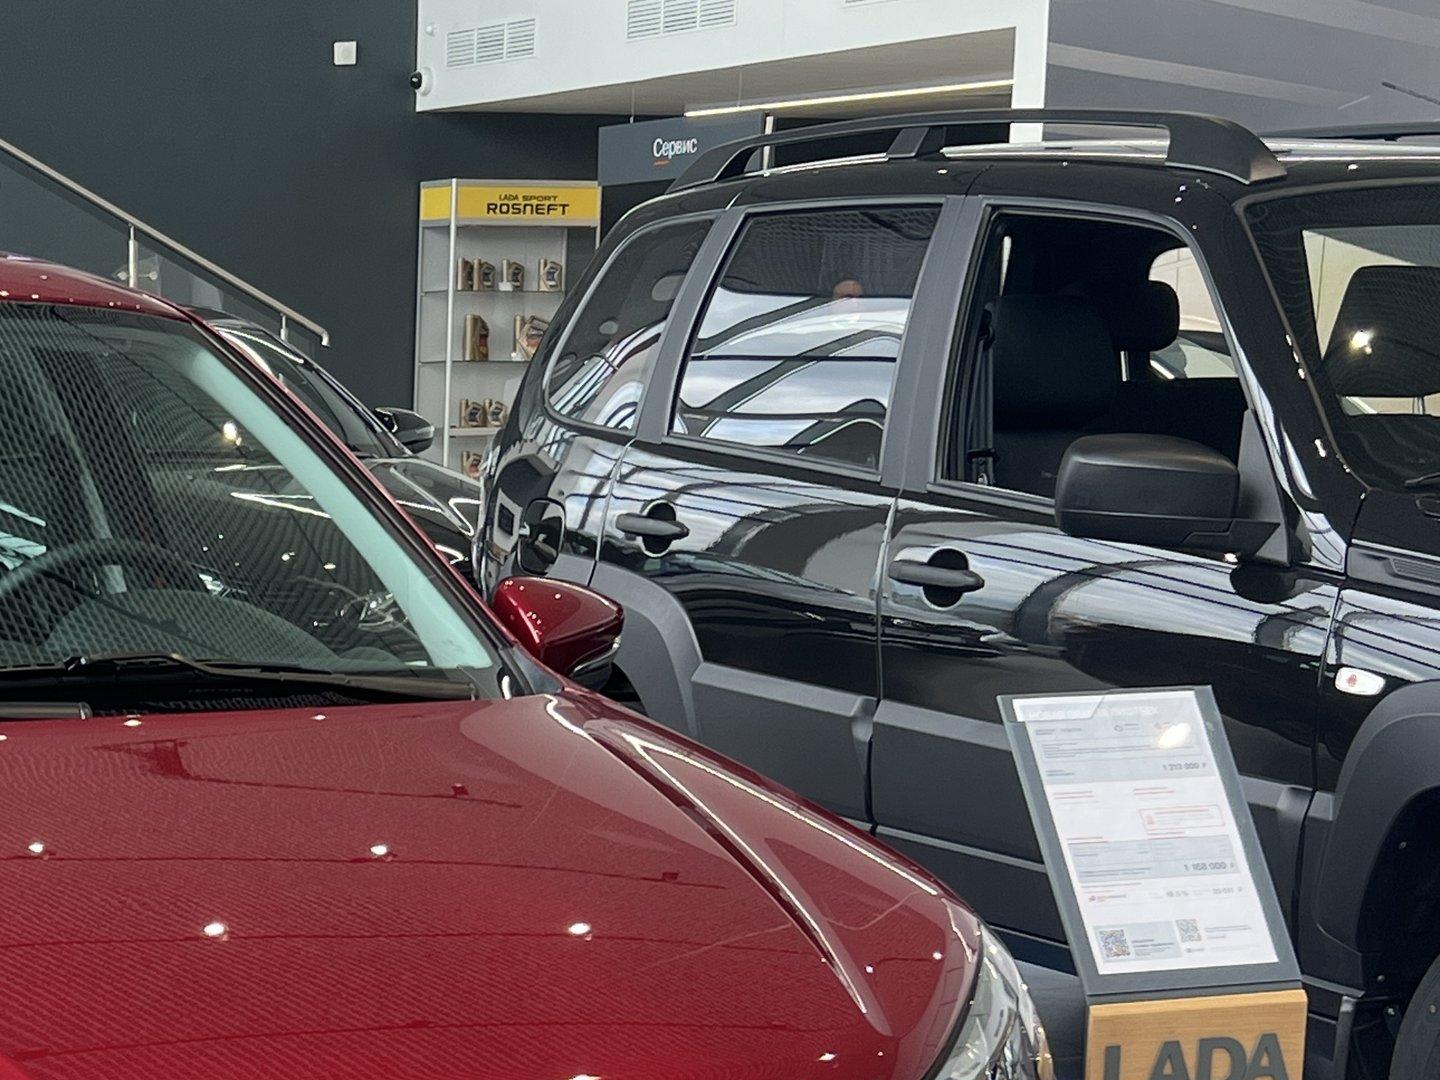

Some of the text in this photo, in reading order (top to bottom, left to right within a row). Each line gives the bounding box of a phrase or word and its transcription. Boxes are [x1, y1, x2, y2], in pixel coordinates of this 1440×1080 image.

[653, 138, 698, 159] Сервис
[499, 193, 558, 202] LADA SPORT
[486, 203, 570, 216] ROSNEFT
